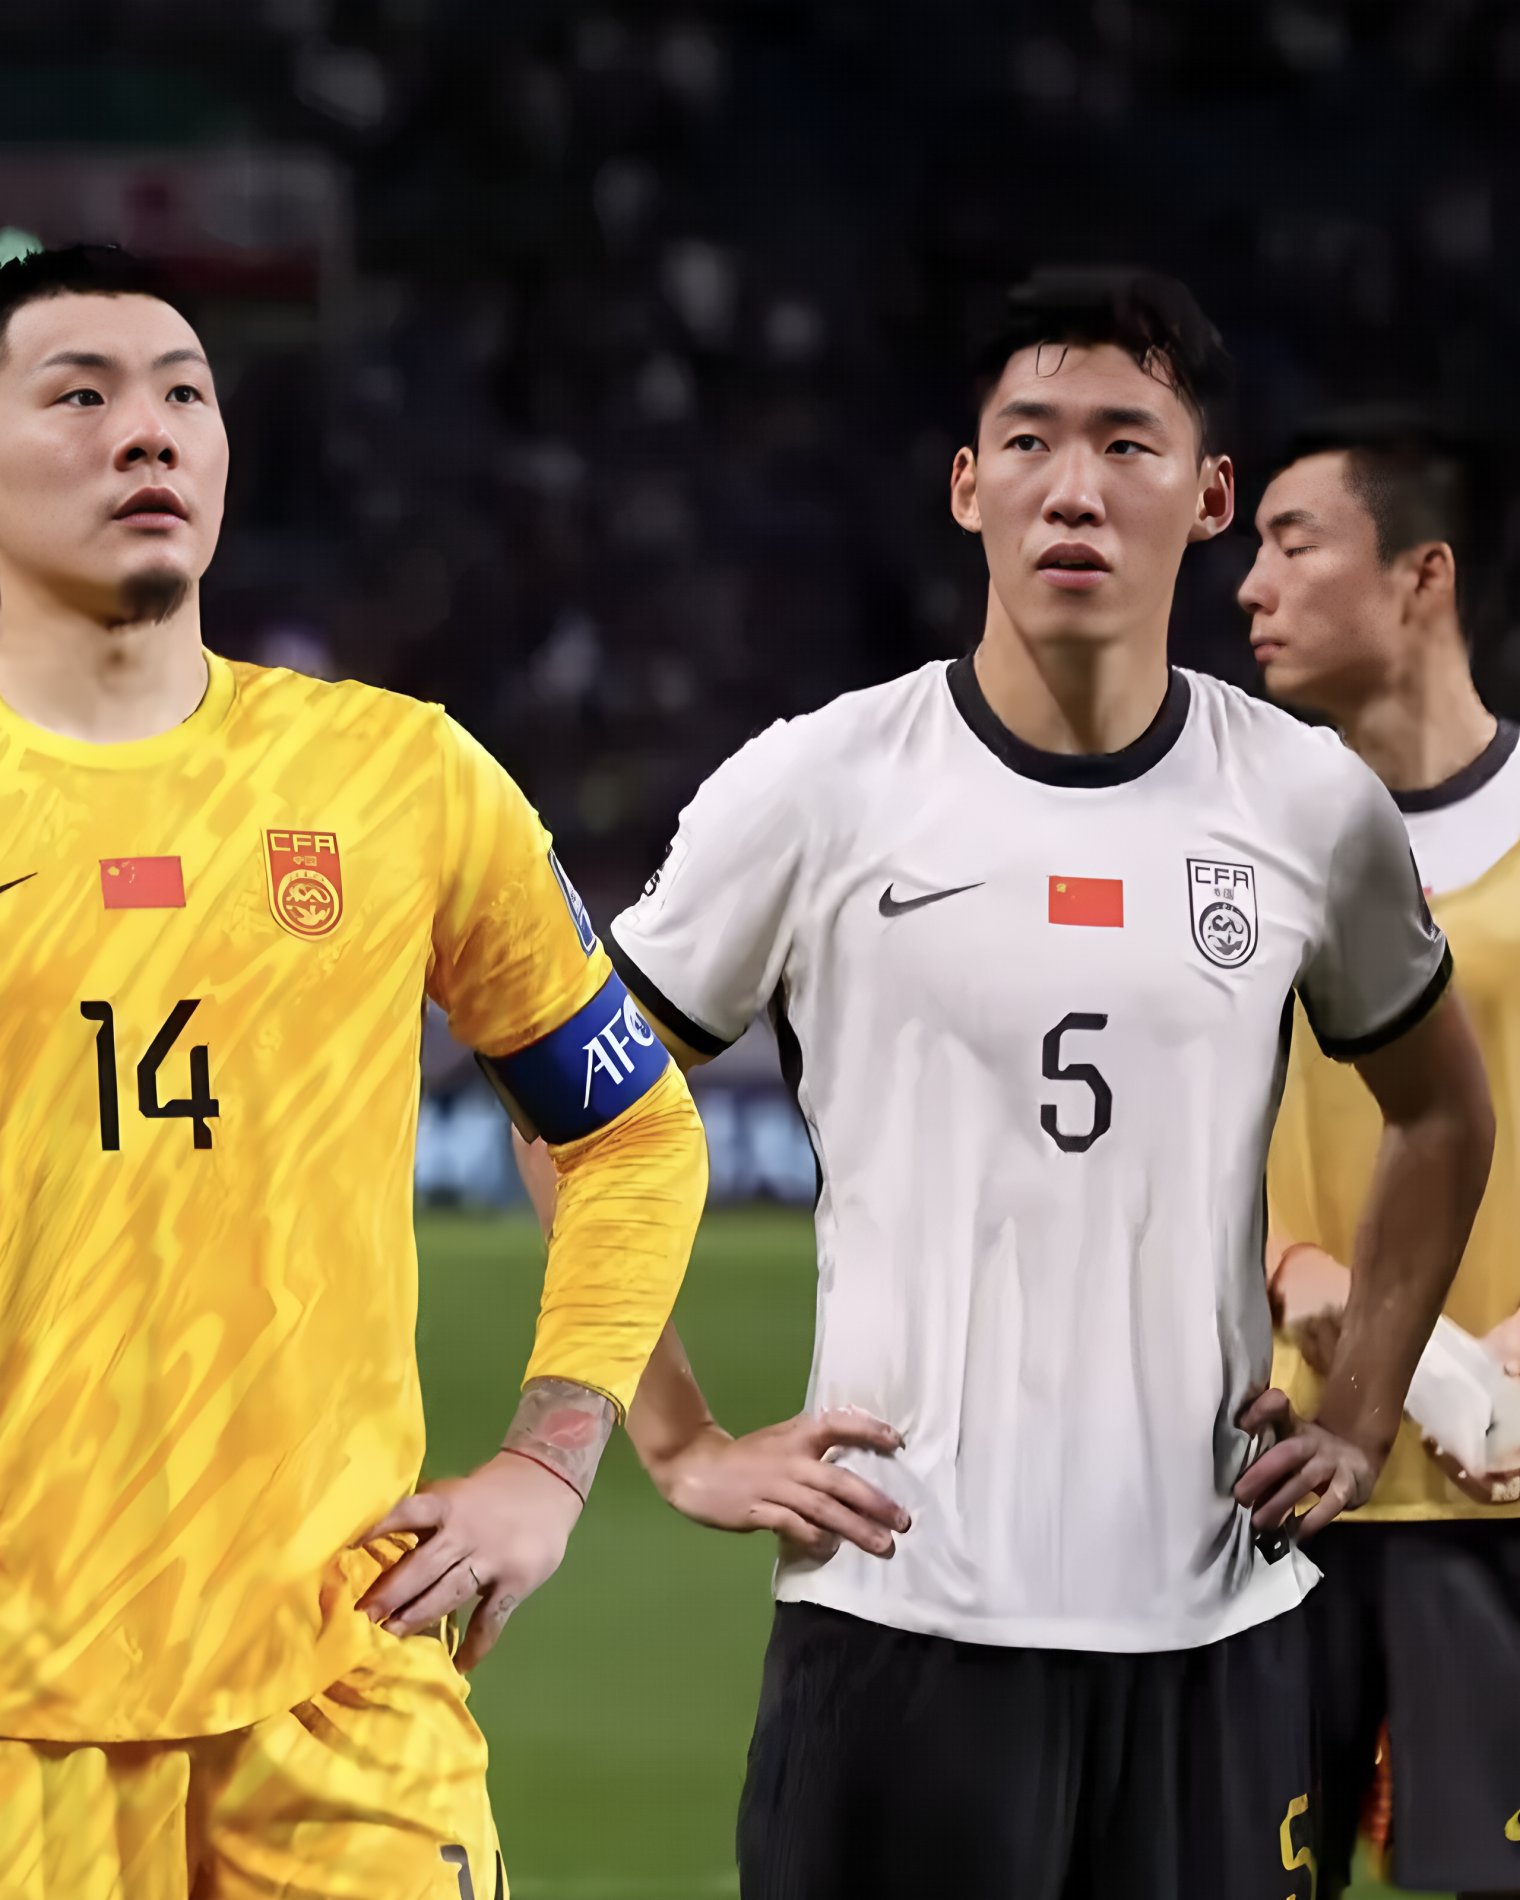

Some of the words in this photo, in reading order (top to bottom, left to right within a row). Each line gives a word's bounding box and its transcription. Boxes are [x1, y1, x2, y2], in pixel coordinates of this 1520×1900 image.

[270, 833, 336, 855] CFA
[1195, 866, 1249, 890] CFA
[80, 999, 220, 1152] 14
[1040, 1012, 1112, 1153] 5
